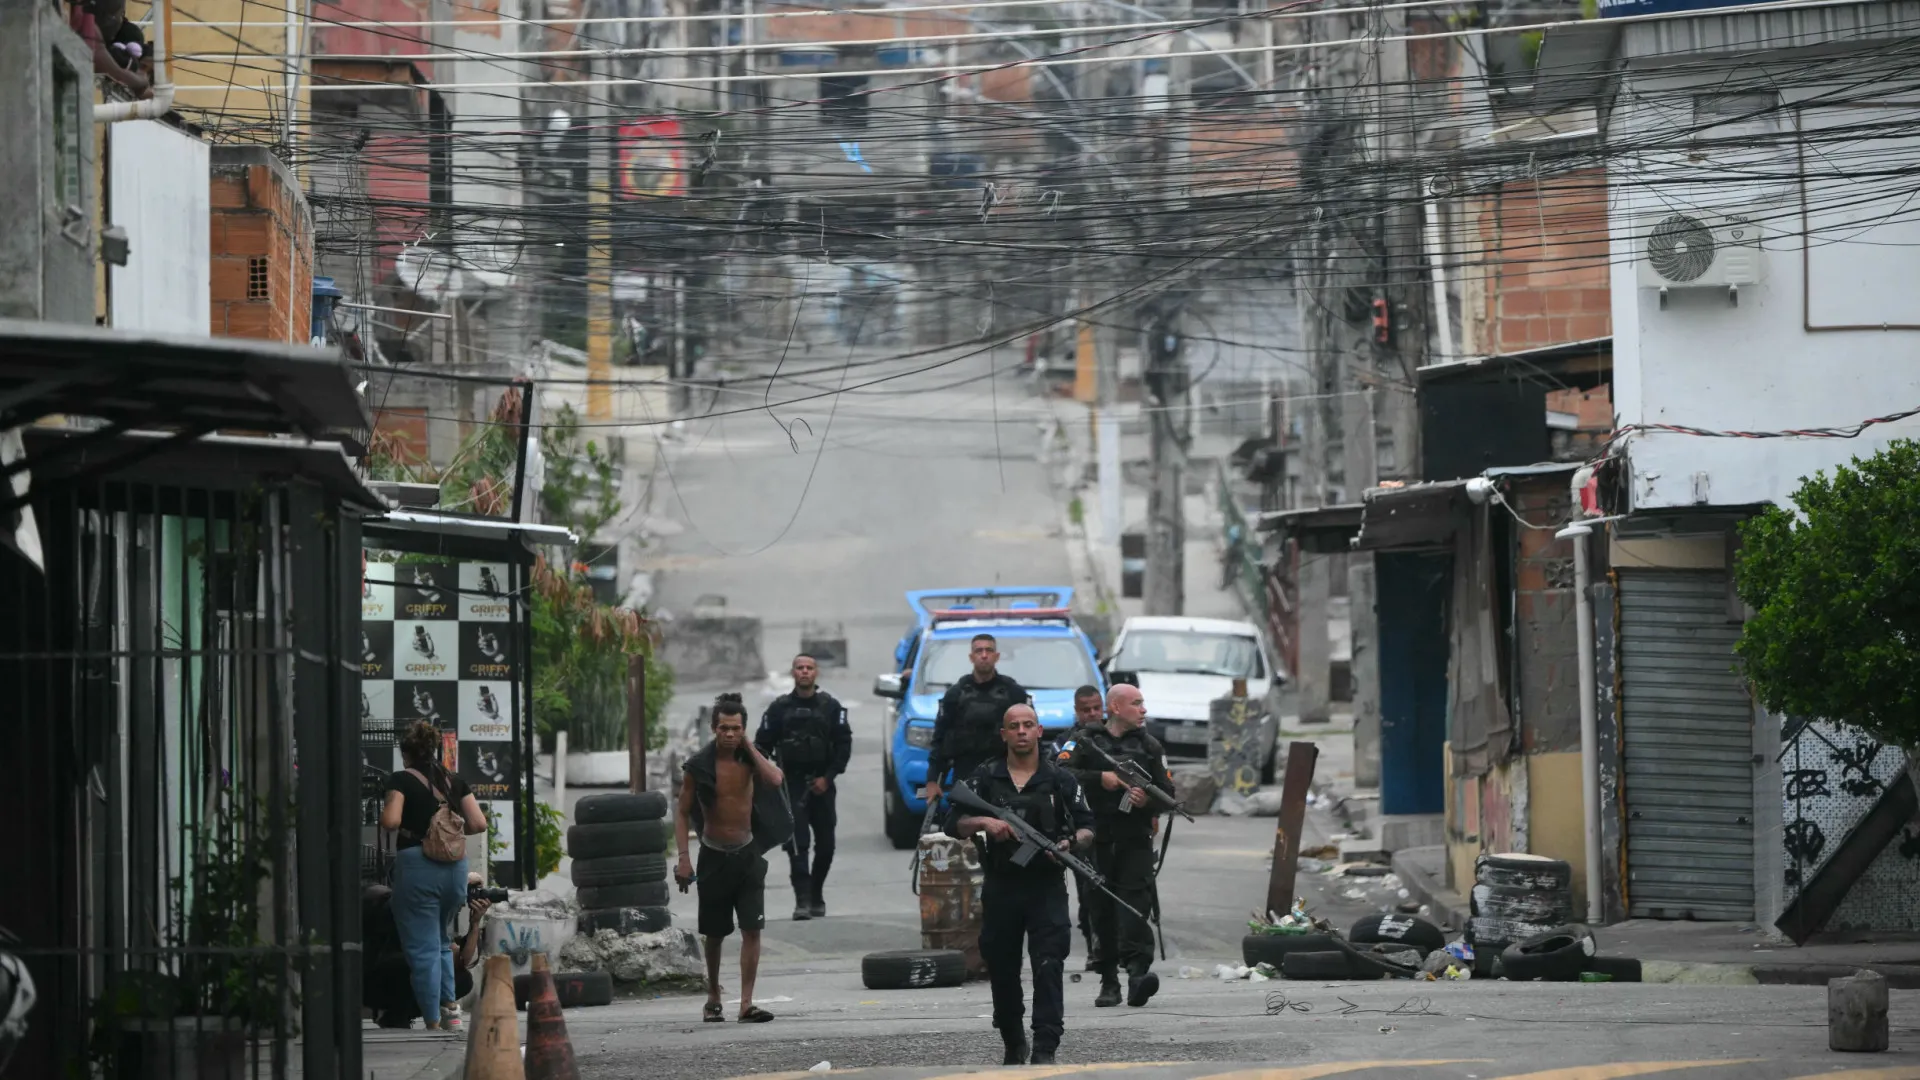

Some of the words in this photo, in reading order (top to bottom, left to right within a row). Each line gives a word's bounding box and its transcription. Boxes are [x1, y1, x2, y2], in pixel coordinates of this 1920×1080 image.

[405, 604, 447, 613] GRIFFY
[470, 604, 511, 613] GRIFFY
[404, 663, 447, 672] GRIFFY
[470, 664, 511, 673] GRIFFY
[469, 724, 511, 733] GRIFFY
[469, 783, 510, 792] GRIFFY
